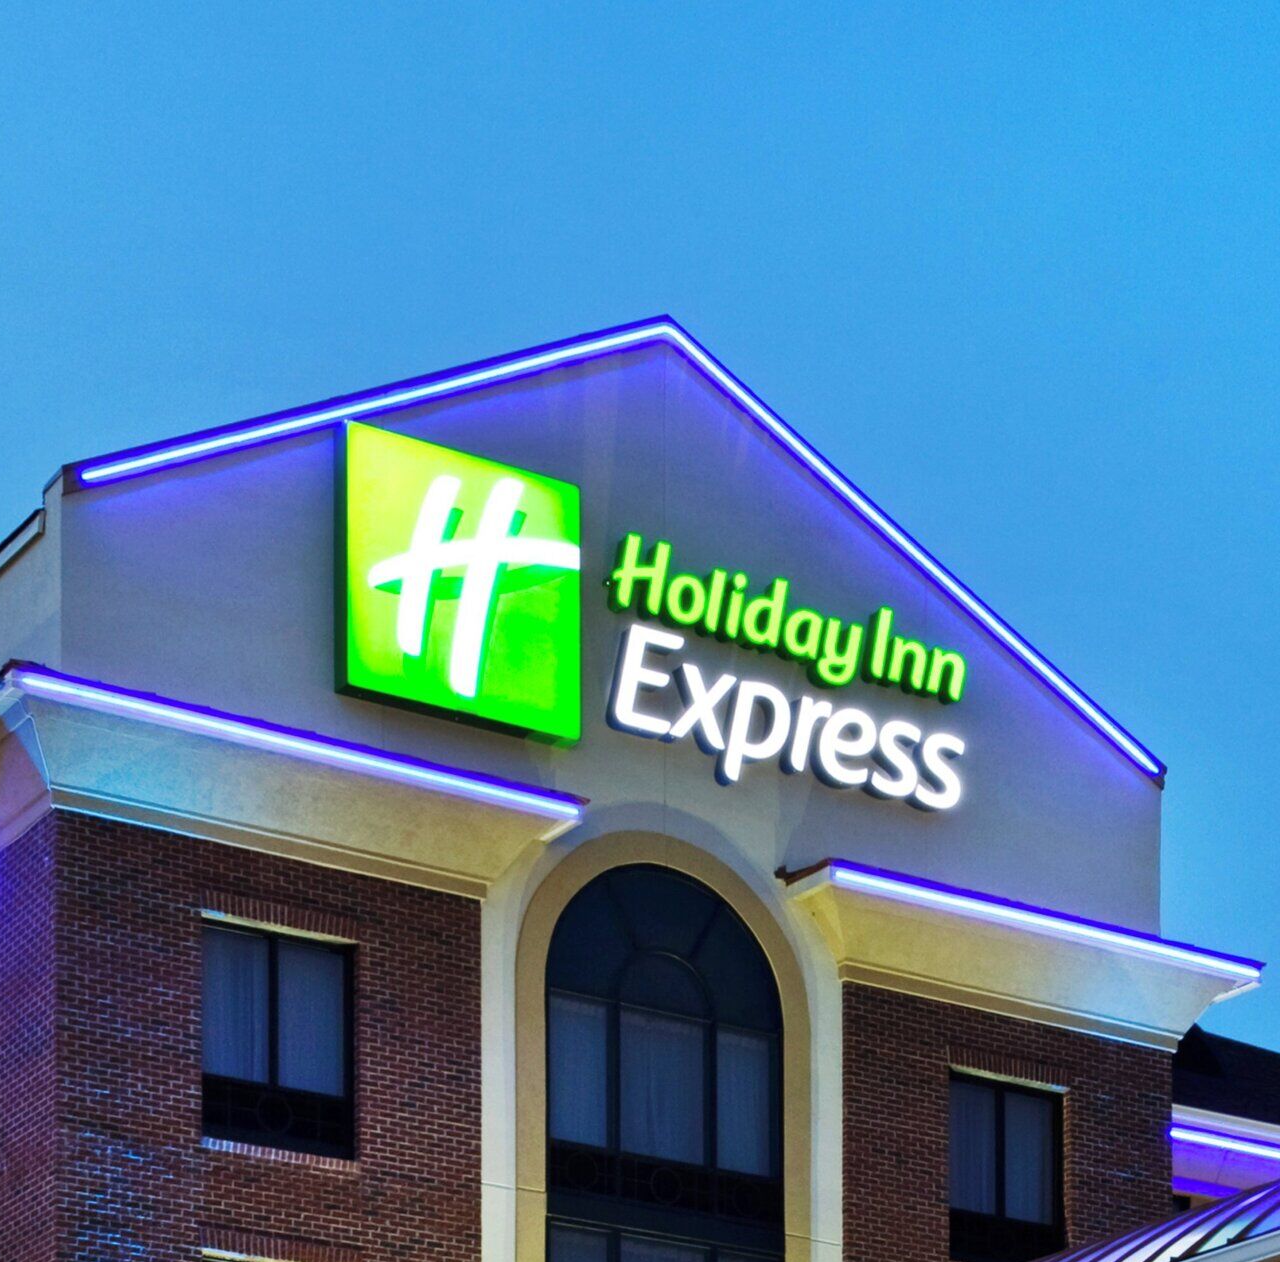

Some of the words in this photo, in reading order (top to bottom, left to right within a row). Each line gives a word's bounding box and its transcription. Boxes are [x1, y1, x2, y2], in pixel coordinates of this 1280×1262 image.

[613, 534, 862, 688] Holiday
[870, 608, 966, 702] Inn
[614, 626, 966, 810] Express
